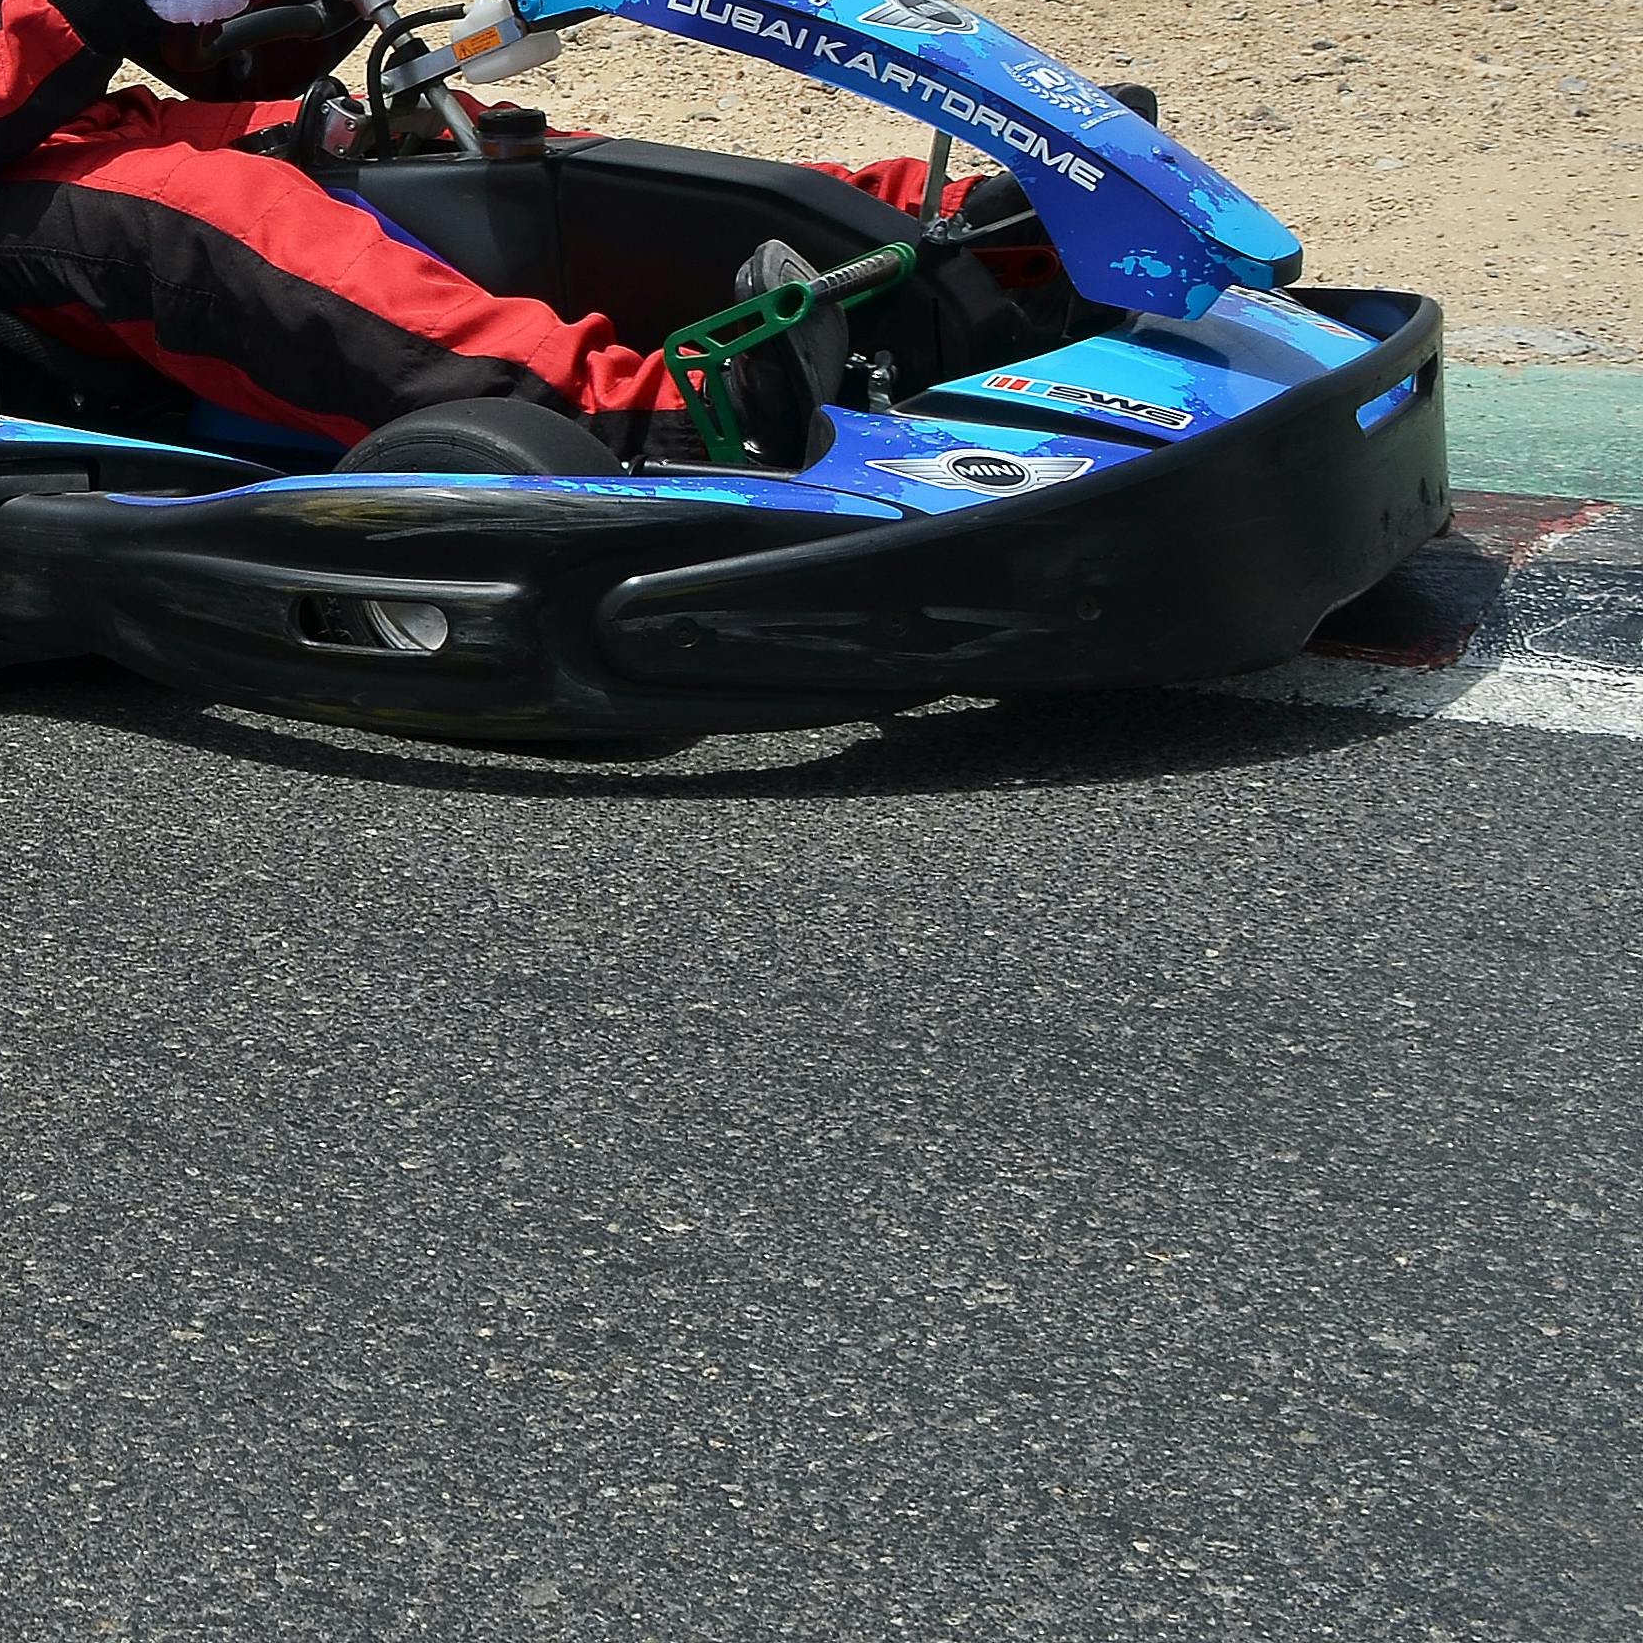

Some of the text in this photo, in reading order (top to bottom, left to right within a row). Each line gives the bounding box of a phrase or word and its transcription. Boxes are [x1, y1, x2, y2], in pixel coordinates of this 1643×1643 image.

[813, 35, 1105, 192] KARTDROME
[1047, 386, 1187, 426] SWS
[953, 464, 1022, 477] MINI
